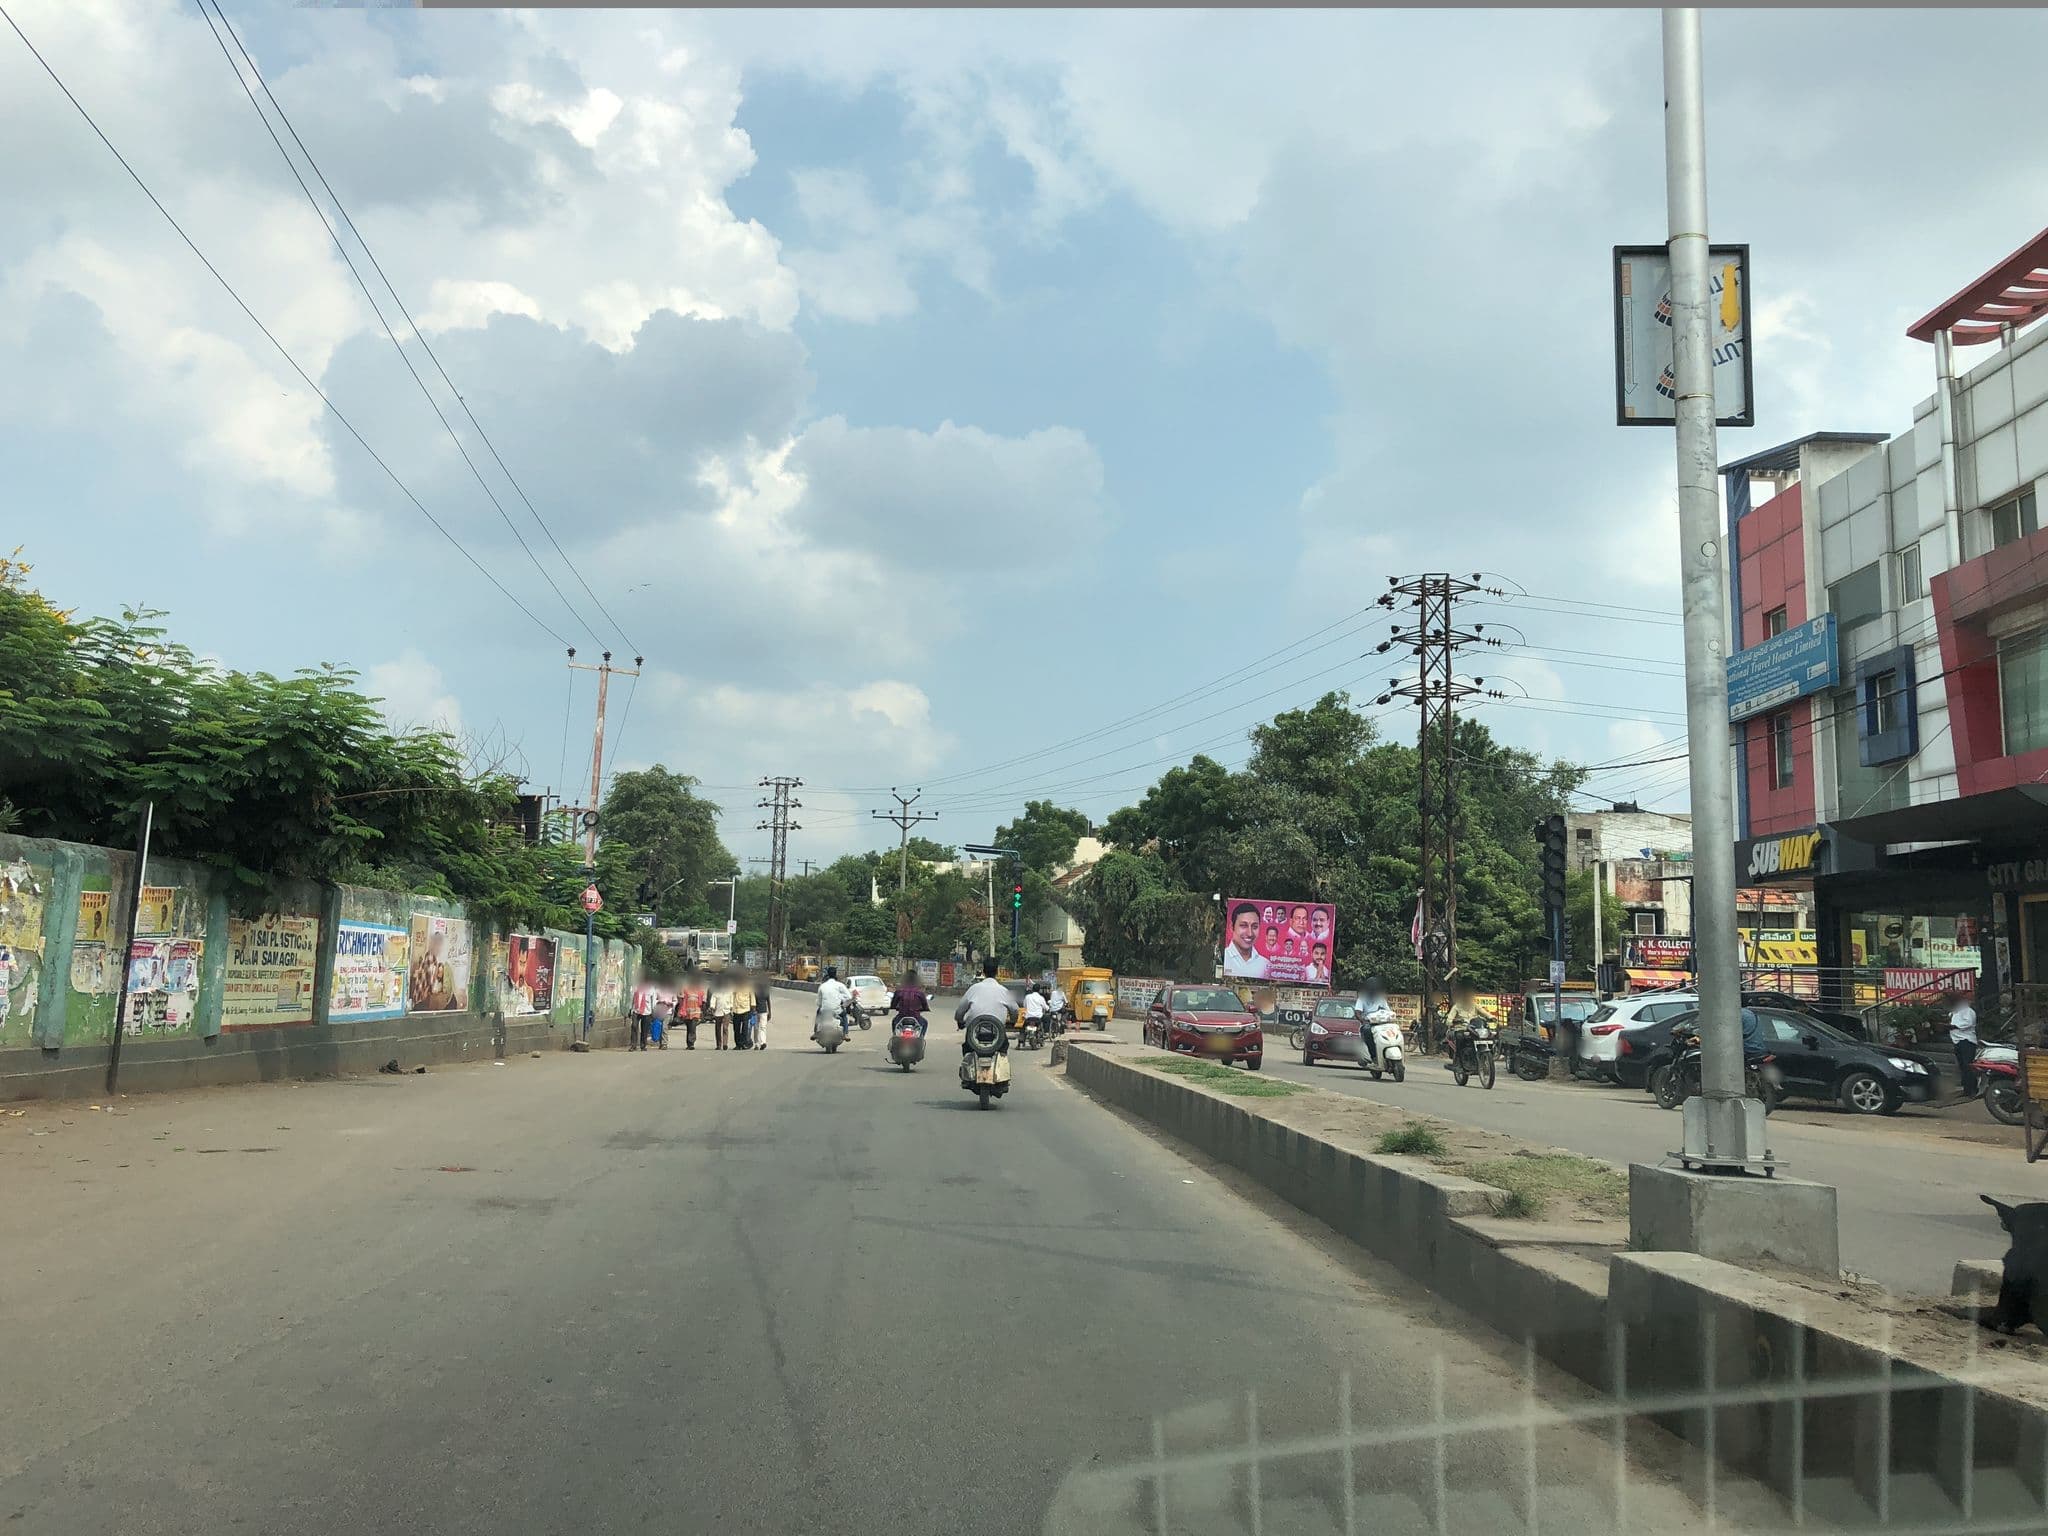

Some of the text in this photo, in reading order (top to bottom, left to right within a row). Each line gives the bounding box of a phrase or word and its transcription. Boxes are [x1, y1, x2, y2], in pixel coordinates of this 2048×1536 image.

[1751, 655, 1771, 674] Travel
[1772, 649, 1793, 666] House
[1795, 632, 1821, 655] Limited
[1748, 829, 1821, 878] SUBWAY
[1885, 971, 1971, 991] MAKHAN SHAH
